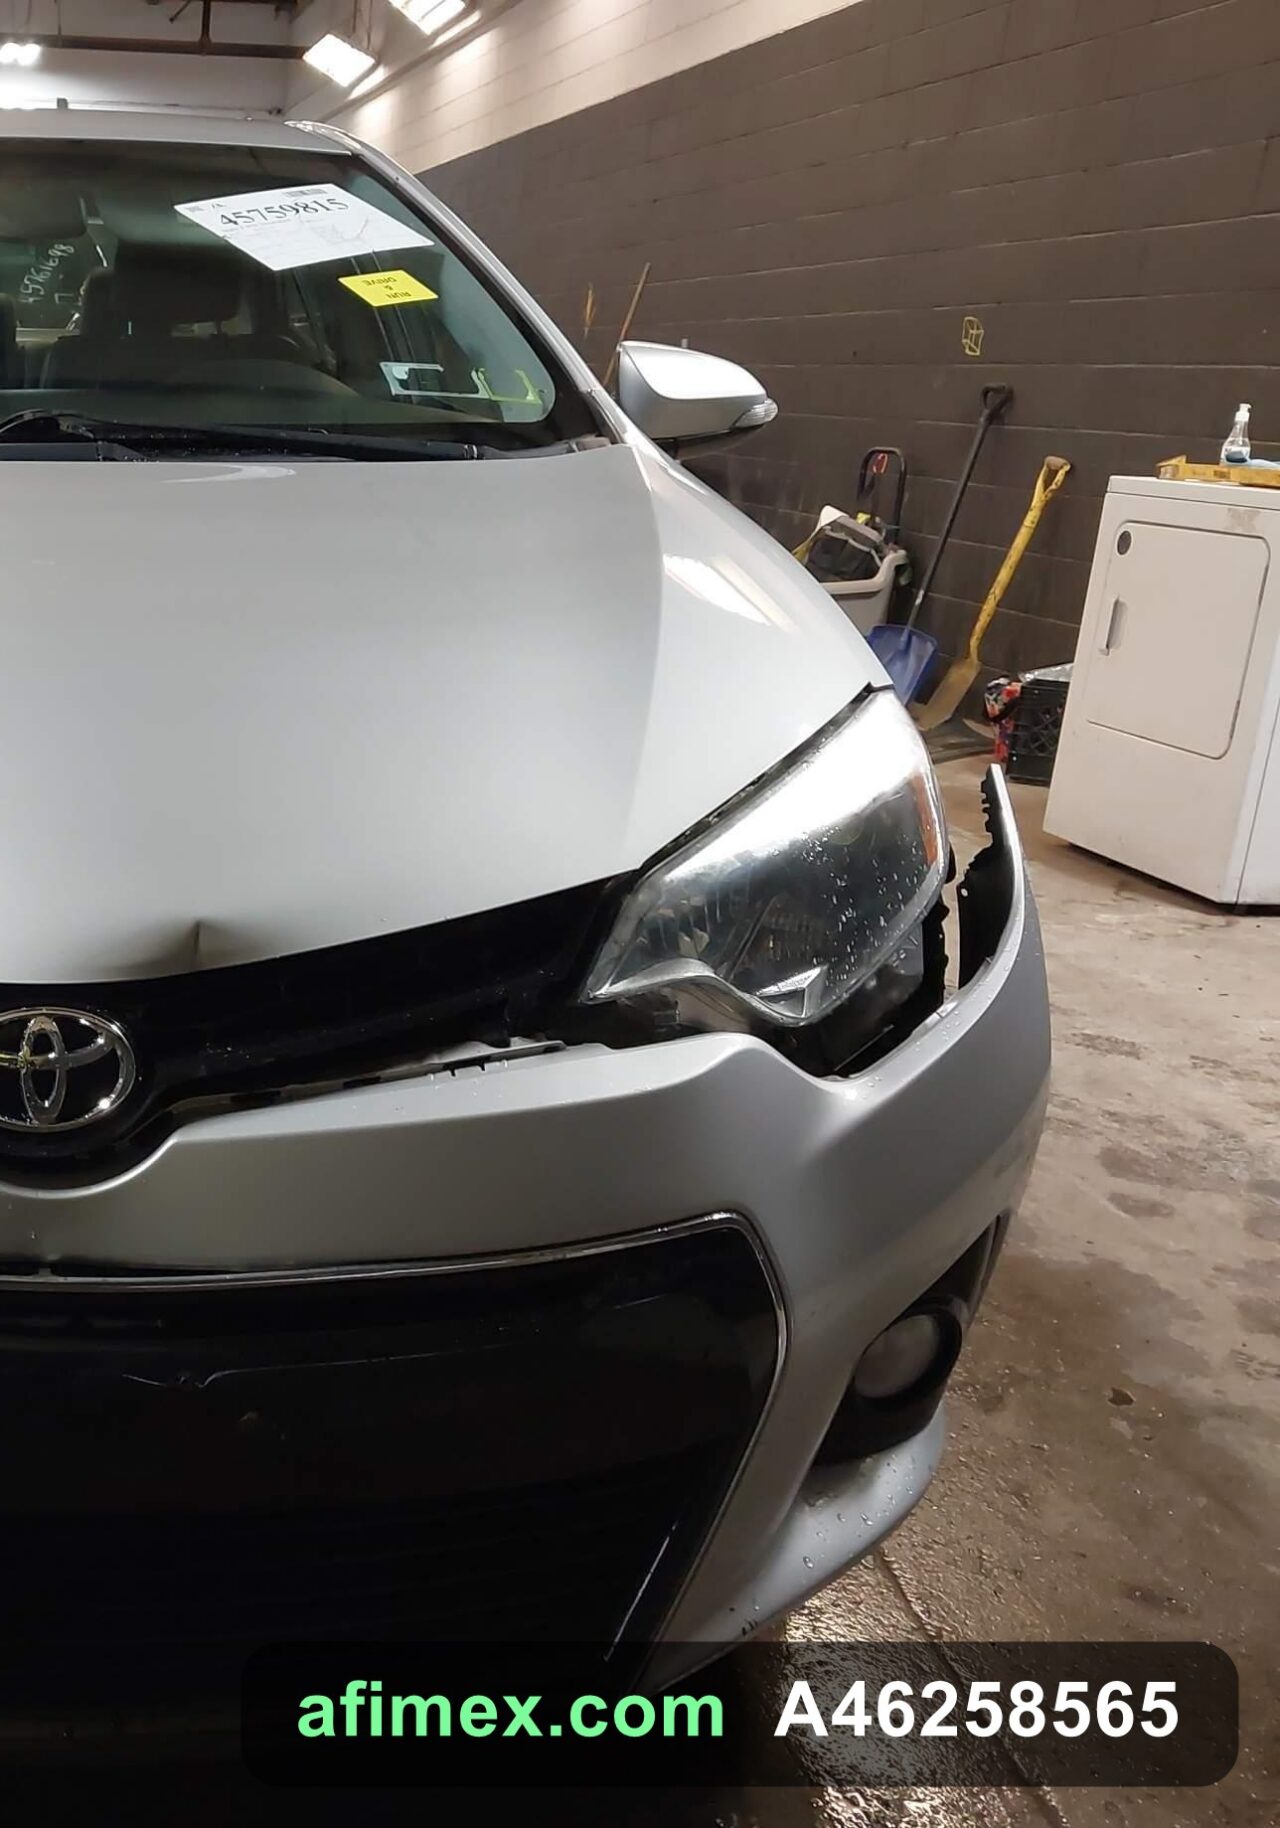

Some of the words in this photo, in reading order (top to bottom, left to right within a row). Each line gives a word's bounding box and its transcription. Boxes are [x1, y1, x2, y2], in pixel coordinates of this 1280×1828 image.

[220, 198, 349, 226] 45759815
[361, 276, 397, 286] DRIVE
[385, 291, 412, 299] RUN
